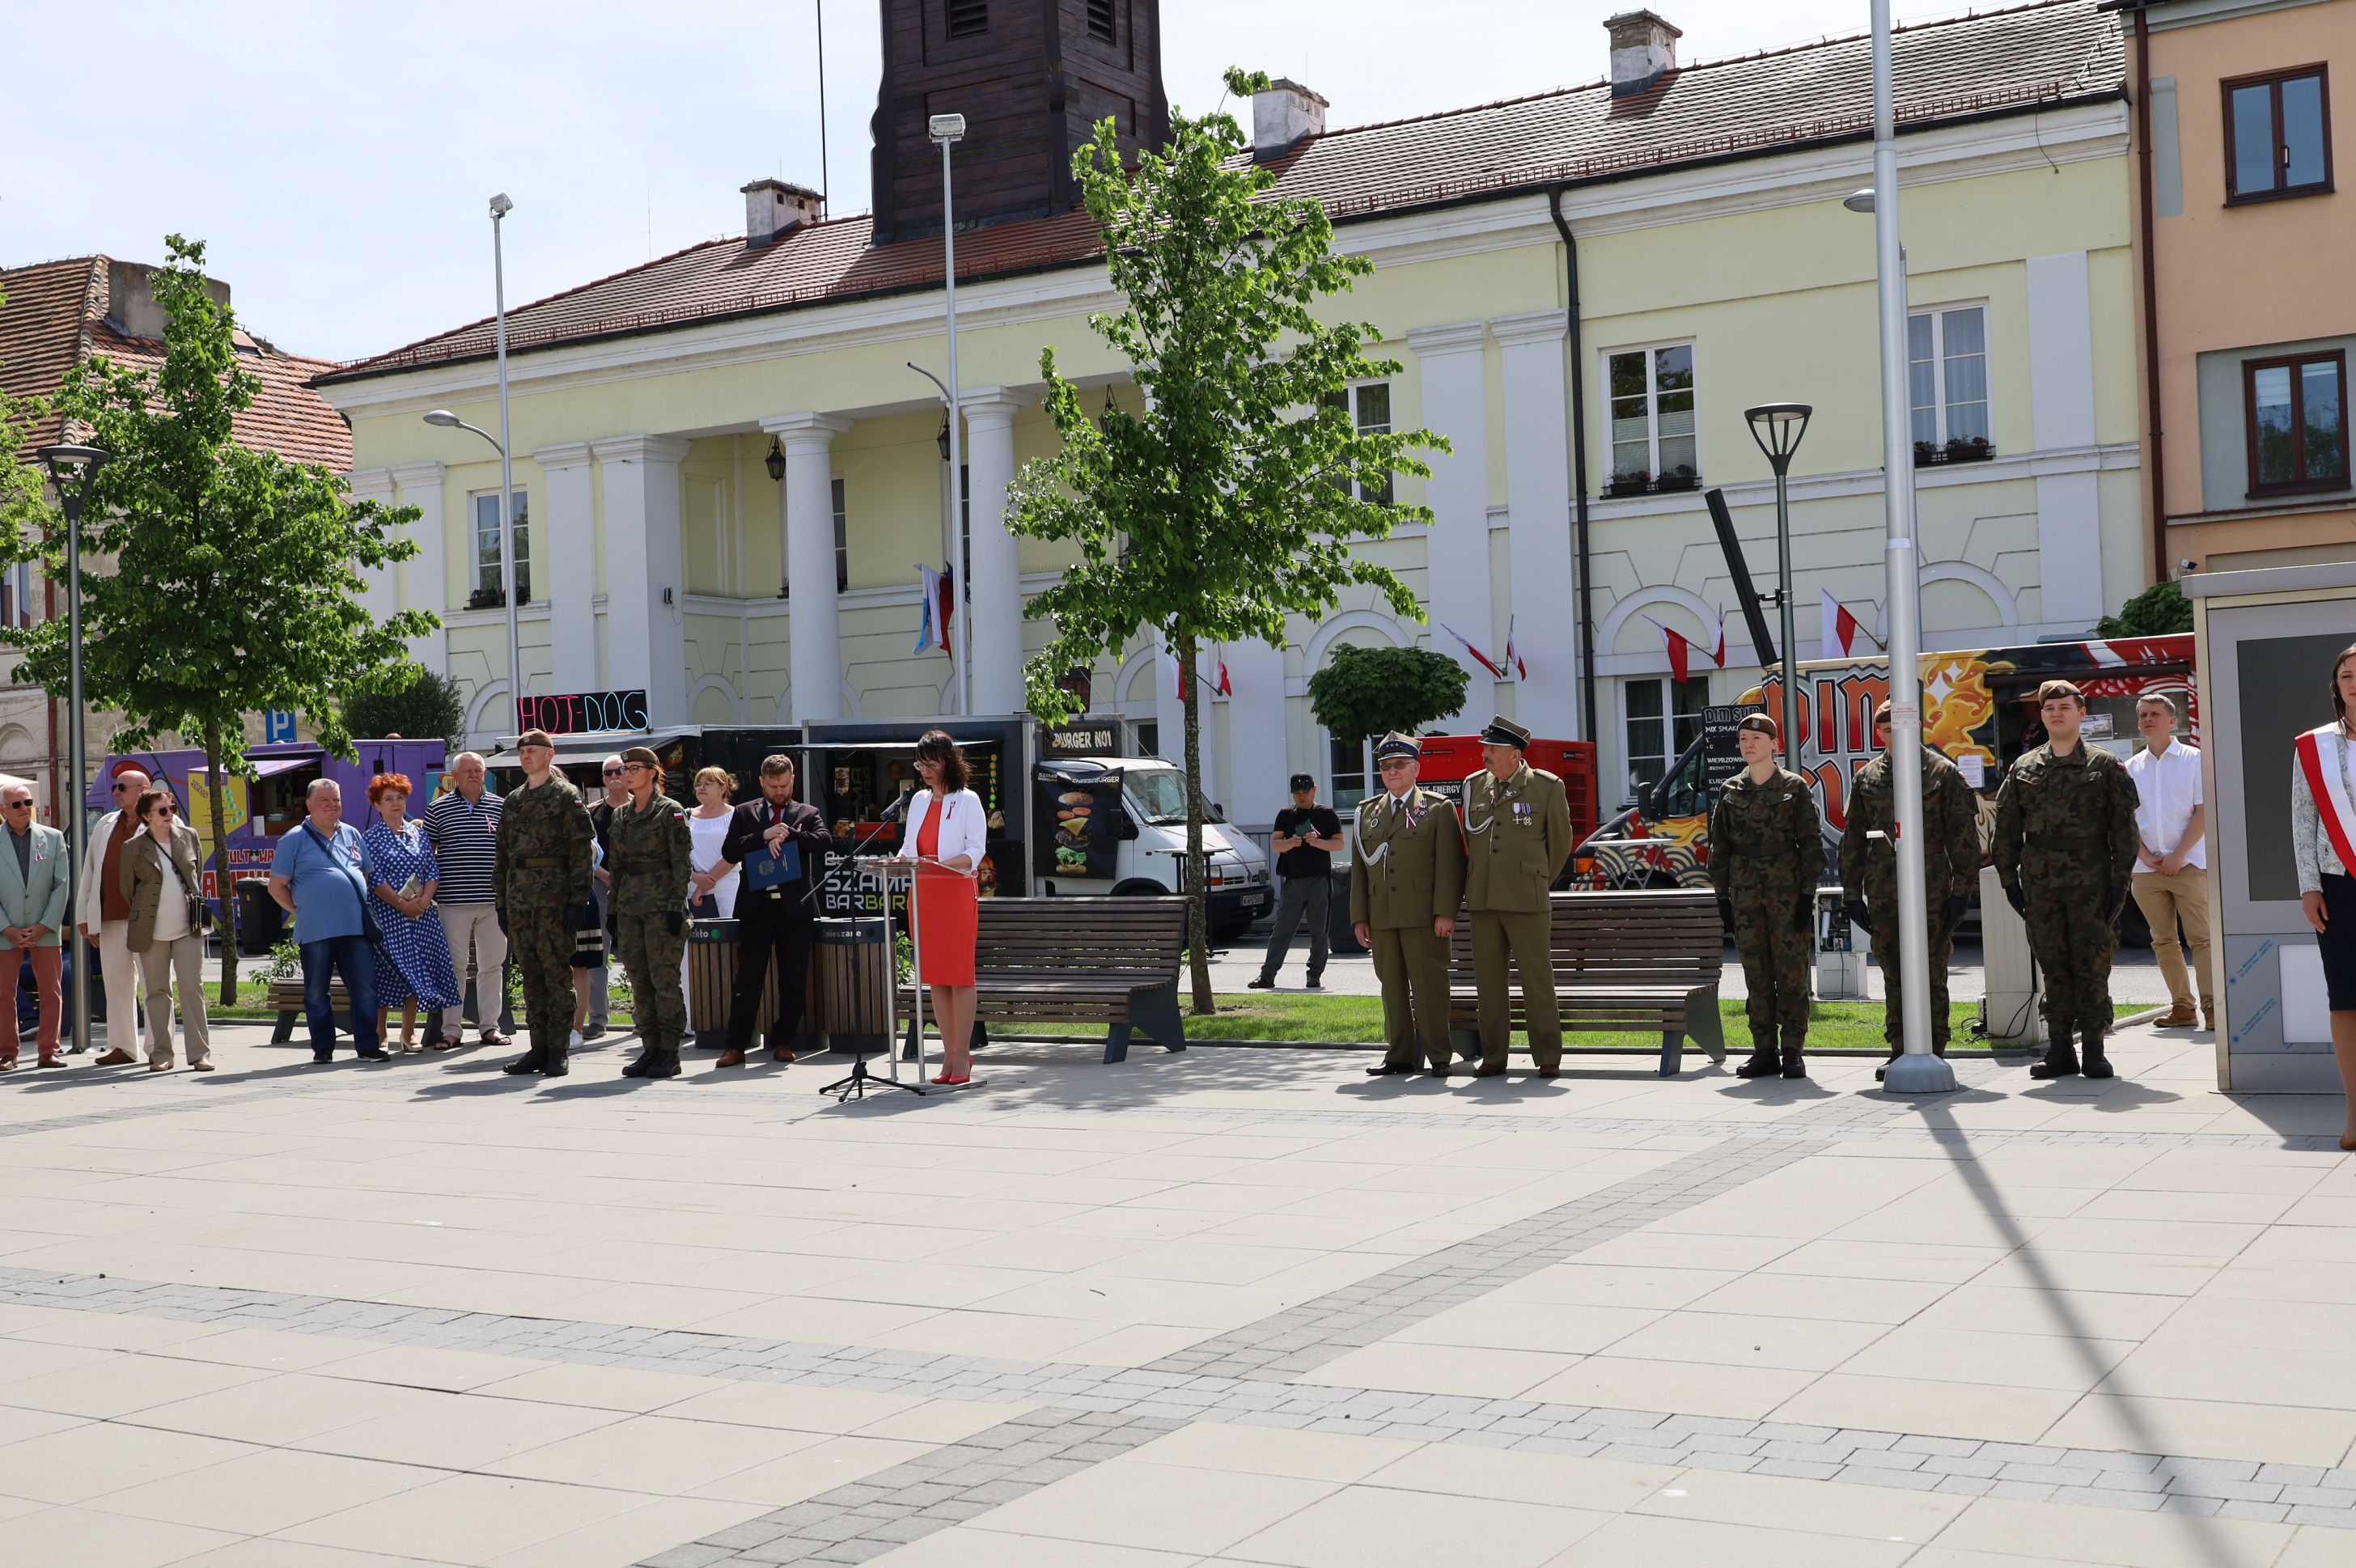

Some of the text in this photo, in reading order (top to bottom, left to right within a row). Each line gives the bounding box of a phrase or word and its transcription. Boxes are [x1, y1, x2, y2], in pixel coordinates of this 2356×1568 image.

[1704, 707, 1731, 723] DIM
[272, 708, 289, 739] P
[1052, 730, 1113, 749] BURGER NO1
[1071, 776, 1120, 784] CHEESEBURGER
[1433, 785, 1461, 795] ENERGY
[689, 928, 709, 938] zkło
